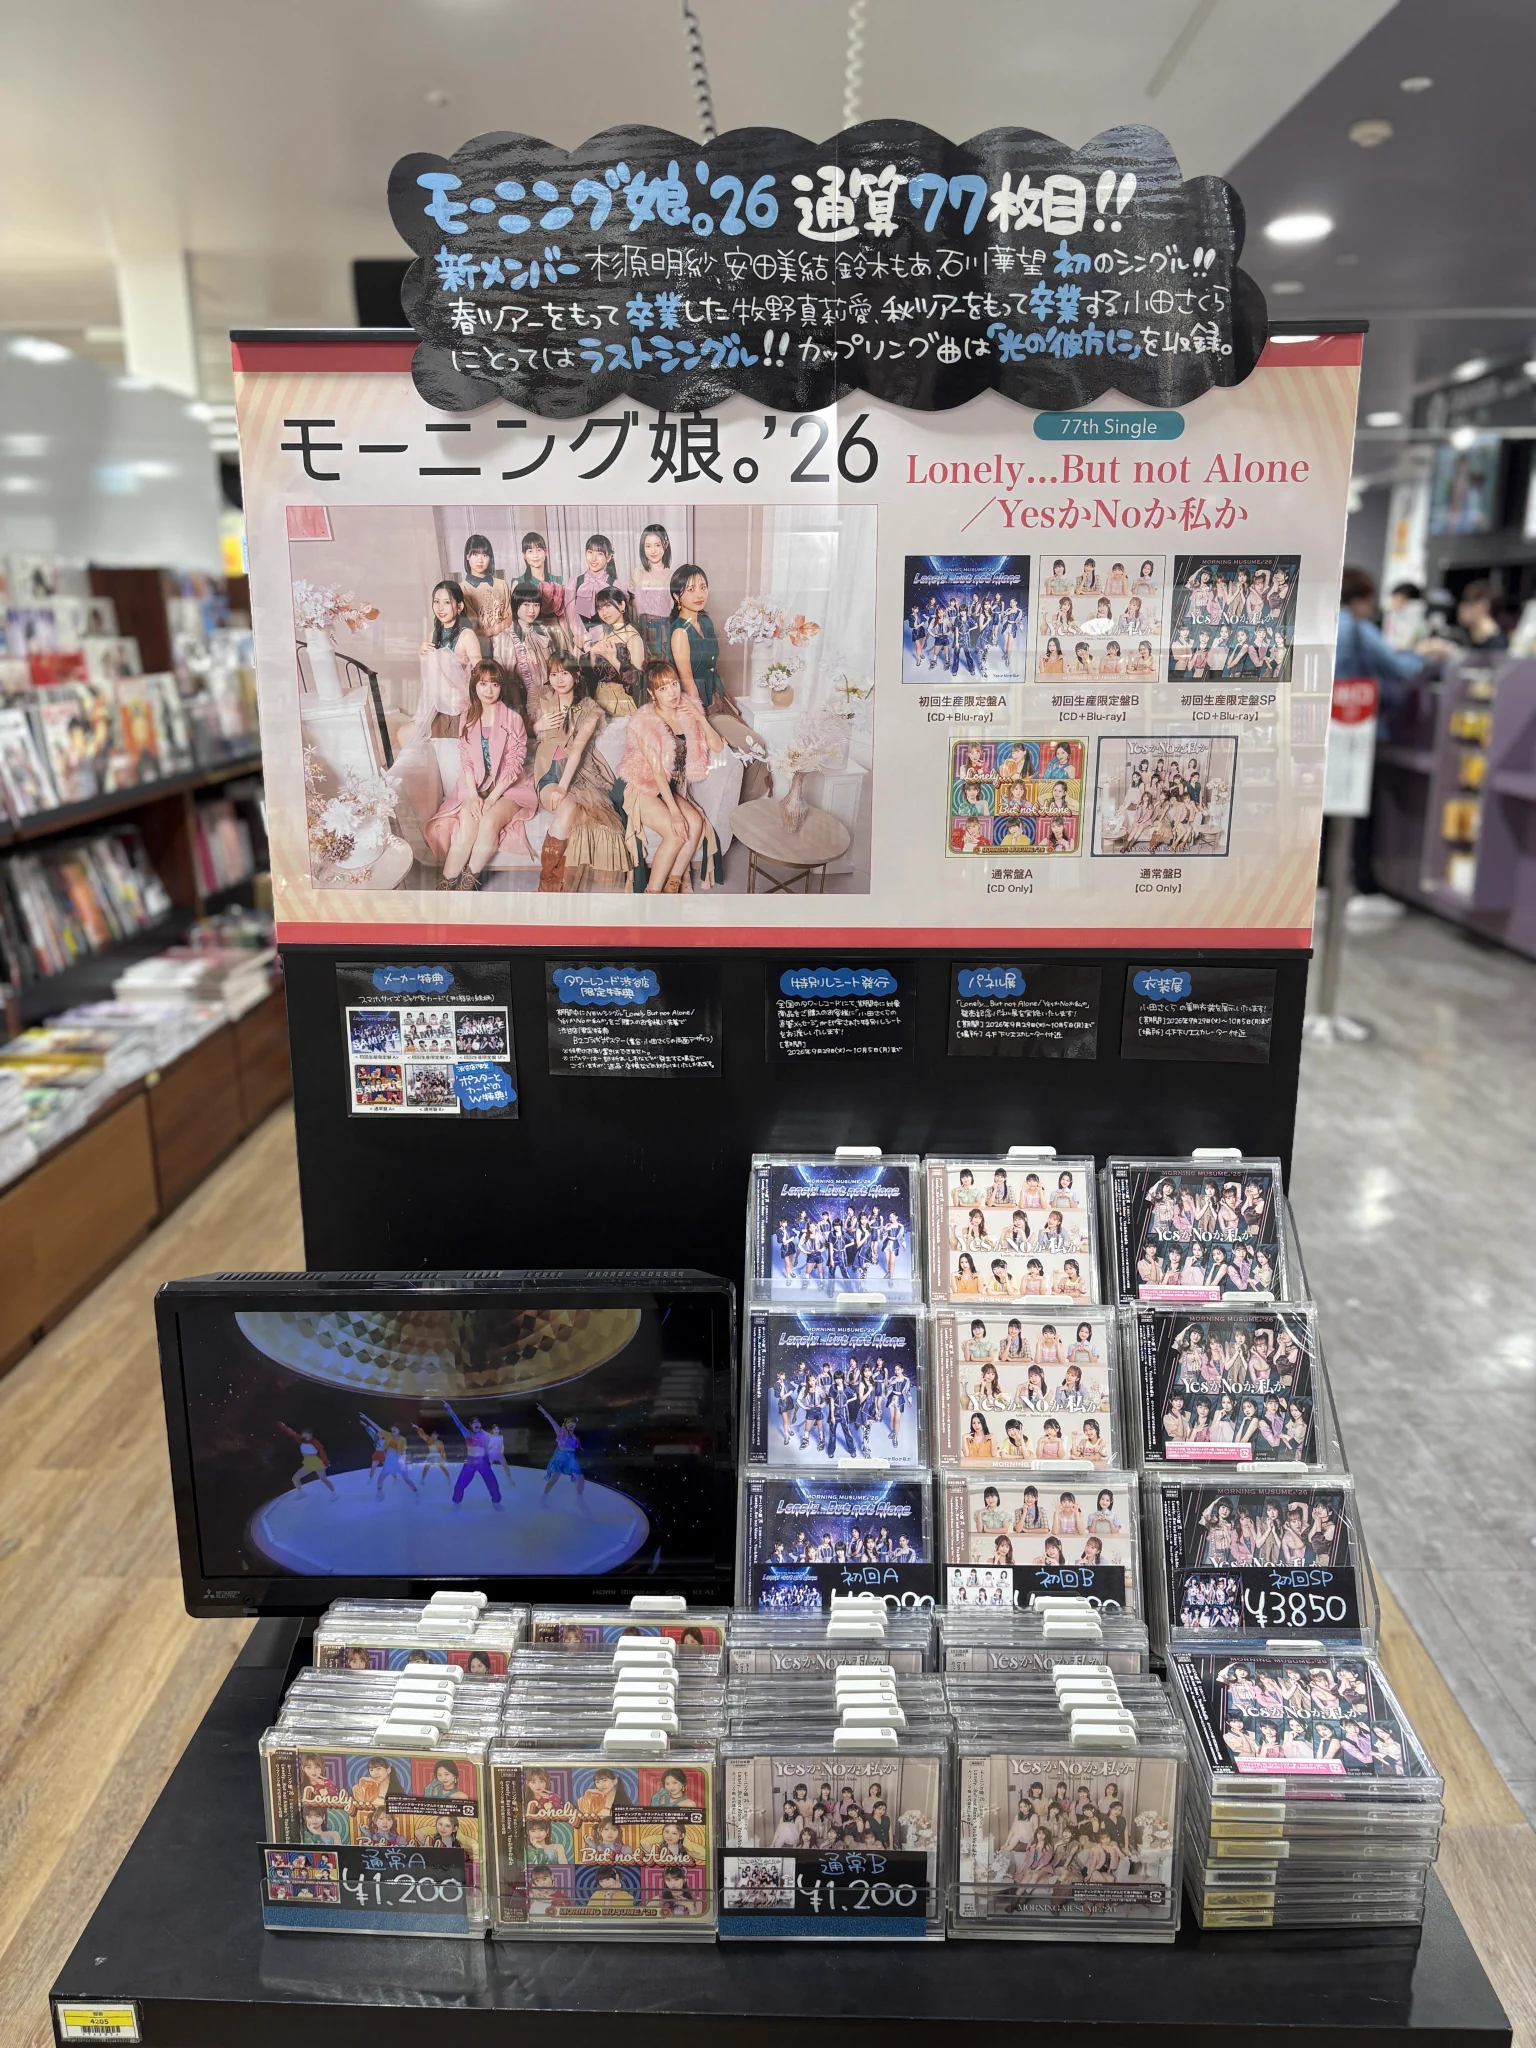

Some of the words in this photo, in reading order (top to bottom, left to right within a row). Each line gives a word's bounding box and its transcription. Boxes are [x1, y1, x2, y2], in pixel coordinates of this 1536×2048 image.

[1060, 419, 1098, 434] 77th
[1104, 419, 1157, 438] Single
[1134, 457, 1191, 484] not
[1205, 453, 1310, 484] Alone
[918, 695, 1007, 708] 初回生産限定盤A
[1051, 695, 1140, 708] 初回生産限定盤B
[1180, 694, 1277, 707] 初回生産限定盤SP
[998, 803, 1018, 814] But
[1020, 803, 1038, 814] not
[1038, 801, 1070, 814] Alone
[991, 868, 1033, 879] 通常盤A
[1140, 868, 1182, 879] 通常盤B
[384, 972, 444, 985] メーカー特典
[790, 975, 890, 989] 特別レシート発行
[968, 972, 1017, 989] パネル展
[1142, 976, 1184, 994] 衣装展
[1181, 1377, 1286, 1395] YesかNoか私か
[967, 1393, 1100, 1414] YesかNoか私か
[841, 1566, 899, 1586] 初回A
[1035, 1568, 1095, 1588] 初回B
[1269, 1569, 1334, 1589] 初回SP
[774, 1761, 898, 1777] YesかNoか私か
[1009, 1759, 1135, 1777] YesかNoか私か
[361, 1848, 426, 1871] 通常A
[582, 1847, 610, 1863] But
[615, 1848, 640, 1863] not
[643, 1844, 691, 1864] Alone
[819, 1852, 887, 1875] 通常B
